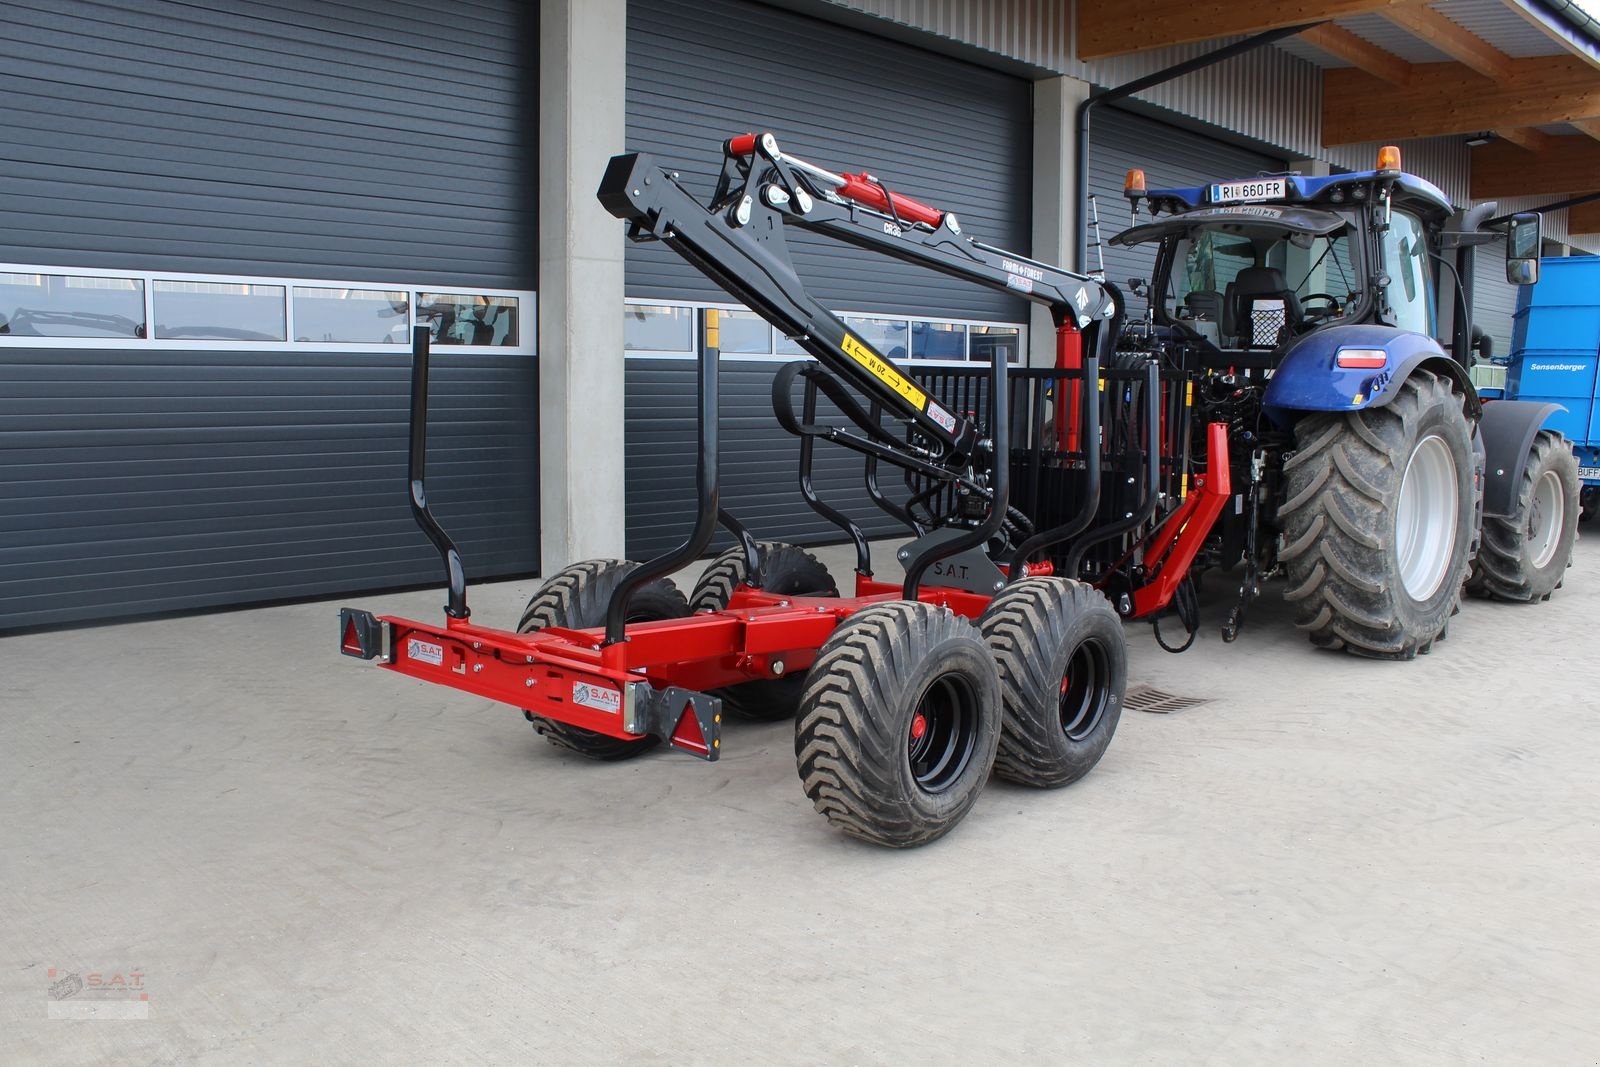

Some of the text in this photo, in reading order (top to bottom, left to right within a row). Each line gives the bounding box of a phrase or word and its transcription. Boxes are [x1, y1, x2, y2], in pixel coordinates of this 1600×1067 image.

[1223, 182, 1280, 199] RI 660 FR
[1530, 363, 1587, 371] Sensenberger
[1577, 467, 1600, 477] BUFF
[934, 561, 969, 580] S.A.T.
[420, 644, 442, 657] S.A.T.
[590, 688, 619, 704] S.A.T.
